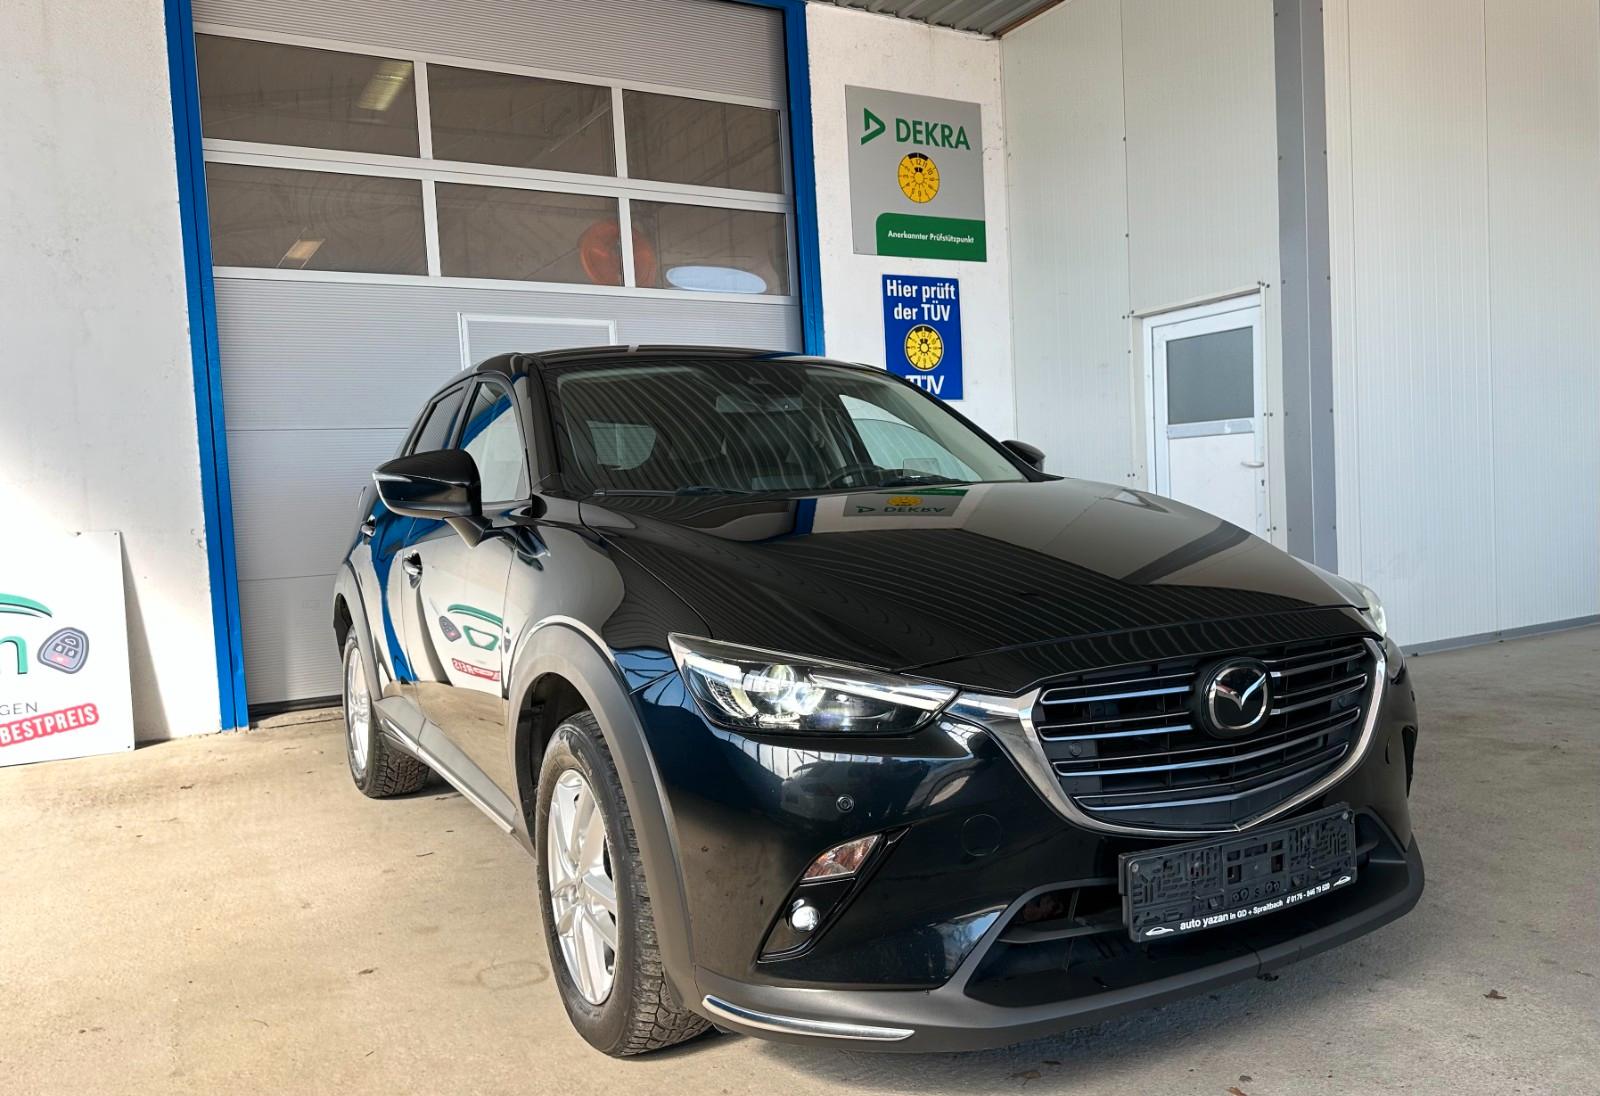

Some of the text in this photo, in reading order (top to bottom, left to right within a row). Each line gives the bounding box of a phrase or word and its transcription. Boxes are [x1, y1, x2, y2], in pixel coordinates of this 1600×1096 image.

[895, 117, 971, 151] DEKRA
[887, 230, 975, 244] Anerkannter Prüfstützpunkt
[886, 279, 956, 303] Hier prüft
[894, 300, 951, 322] der TÜV
[0, 704, 96, 745] BESTPREIS
[1180, 918, 1201, 931] auto
[1202, 912, 1229, 928] yazan
[1229, 912, 1236, 920] in
